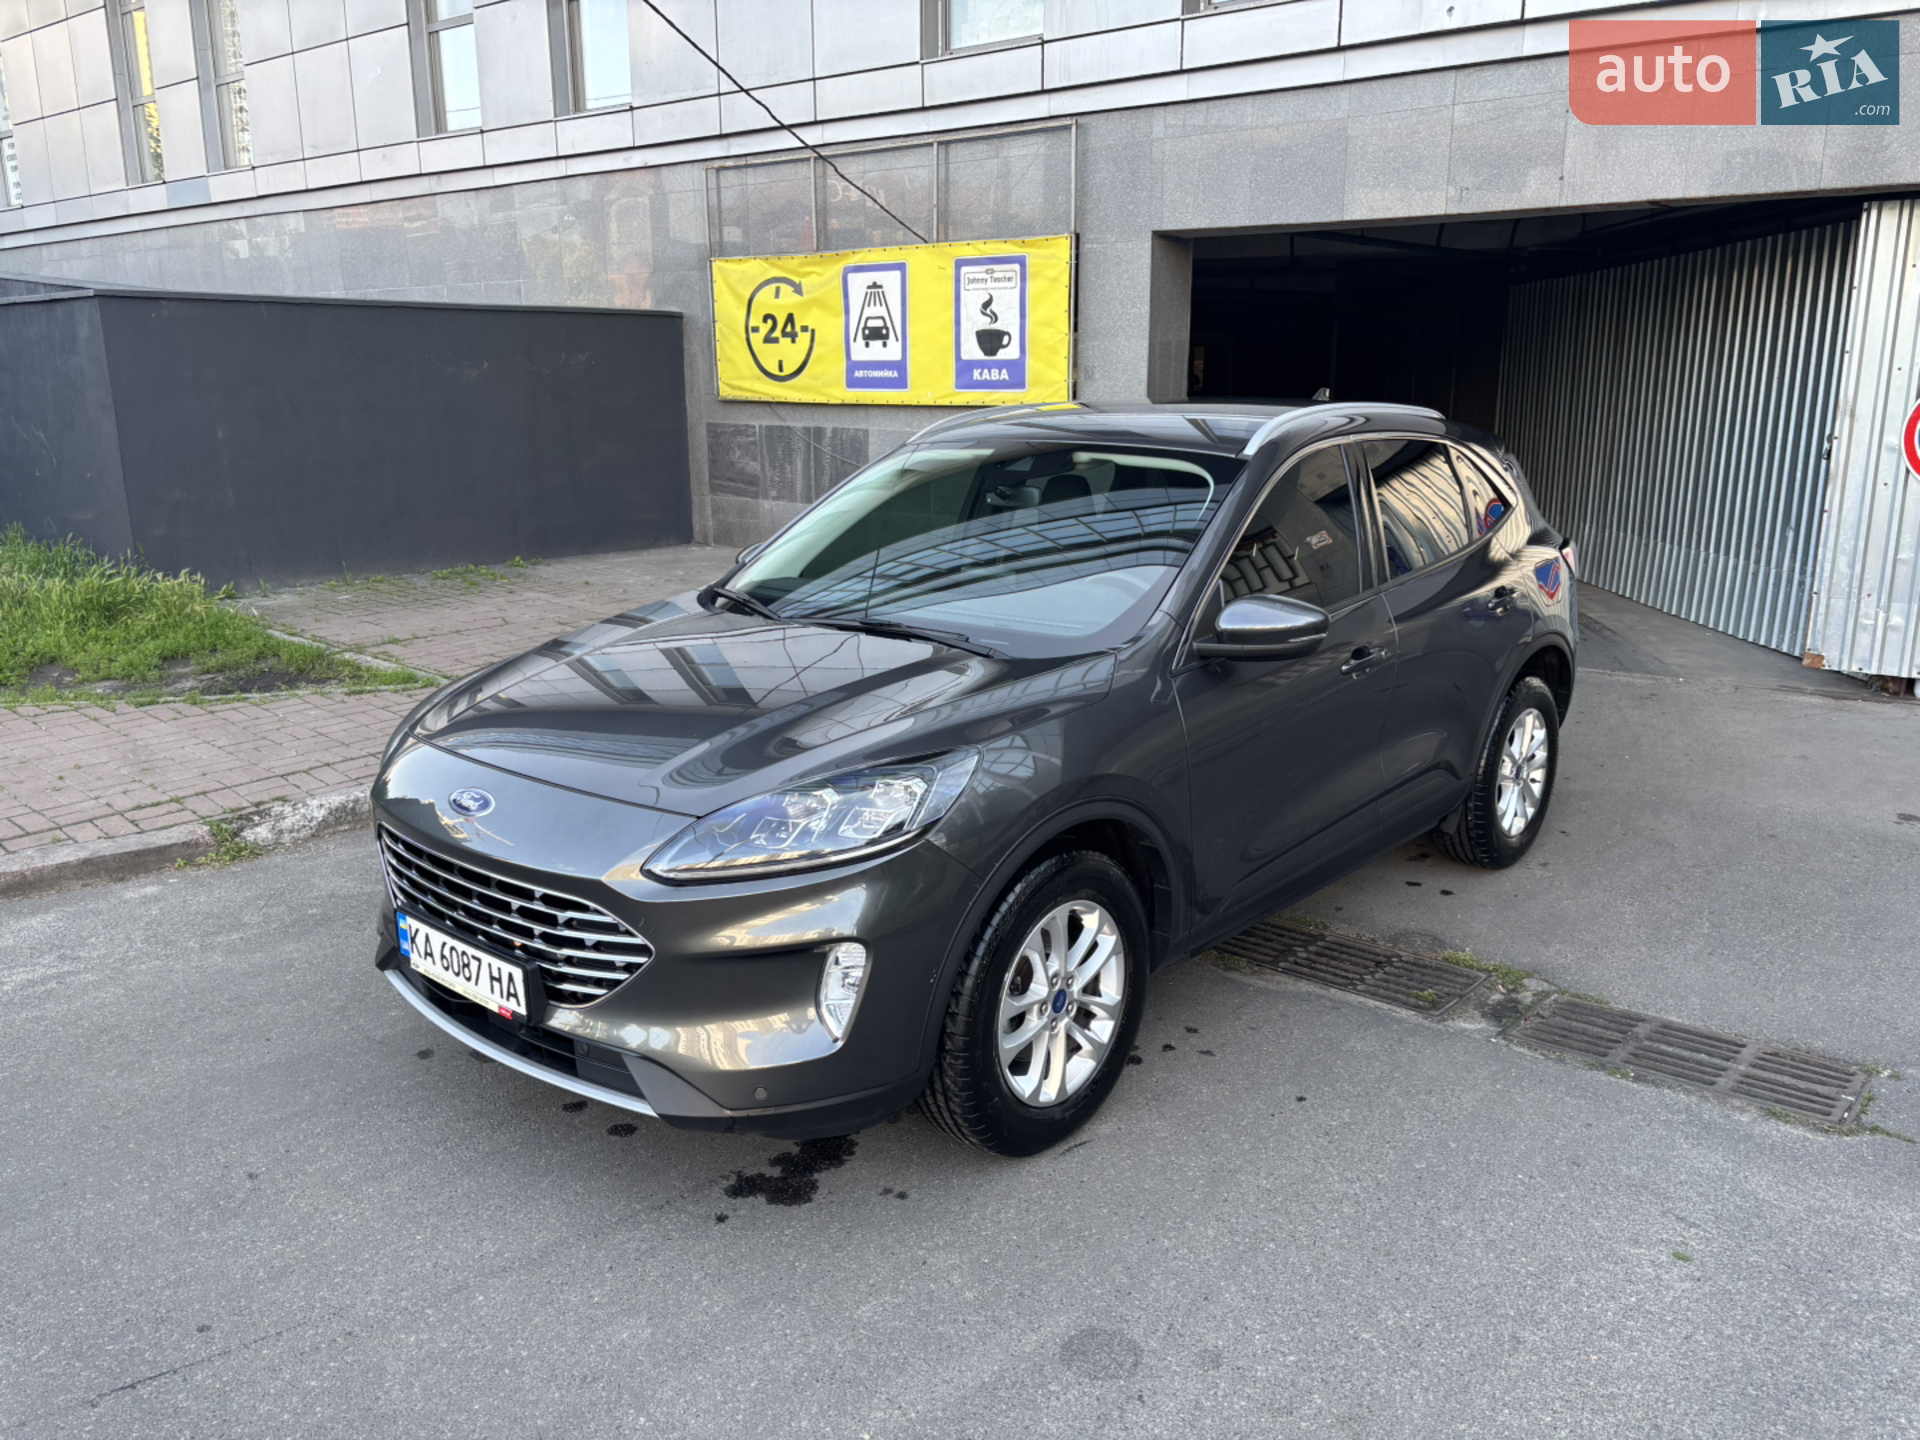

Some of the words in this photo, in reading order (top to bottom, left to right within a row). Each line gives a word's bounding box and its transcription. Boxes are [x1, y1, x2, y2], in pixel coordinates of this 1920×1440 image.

[853, 368, 899, 378] АВТОМИЙКА
[973, 368, 1009, 381] КАВА
[408, 923, 436, 966] KA
[440, 941, 482, 987] 6087
[488, 962, 521, 1008] HA
